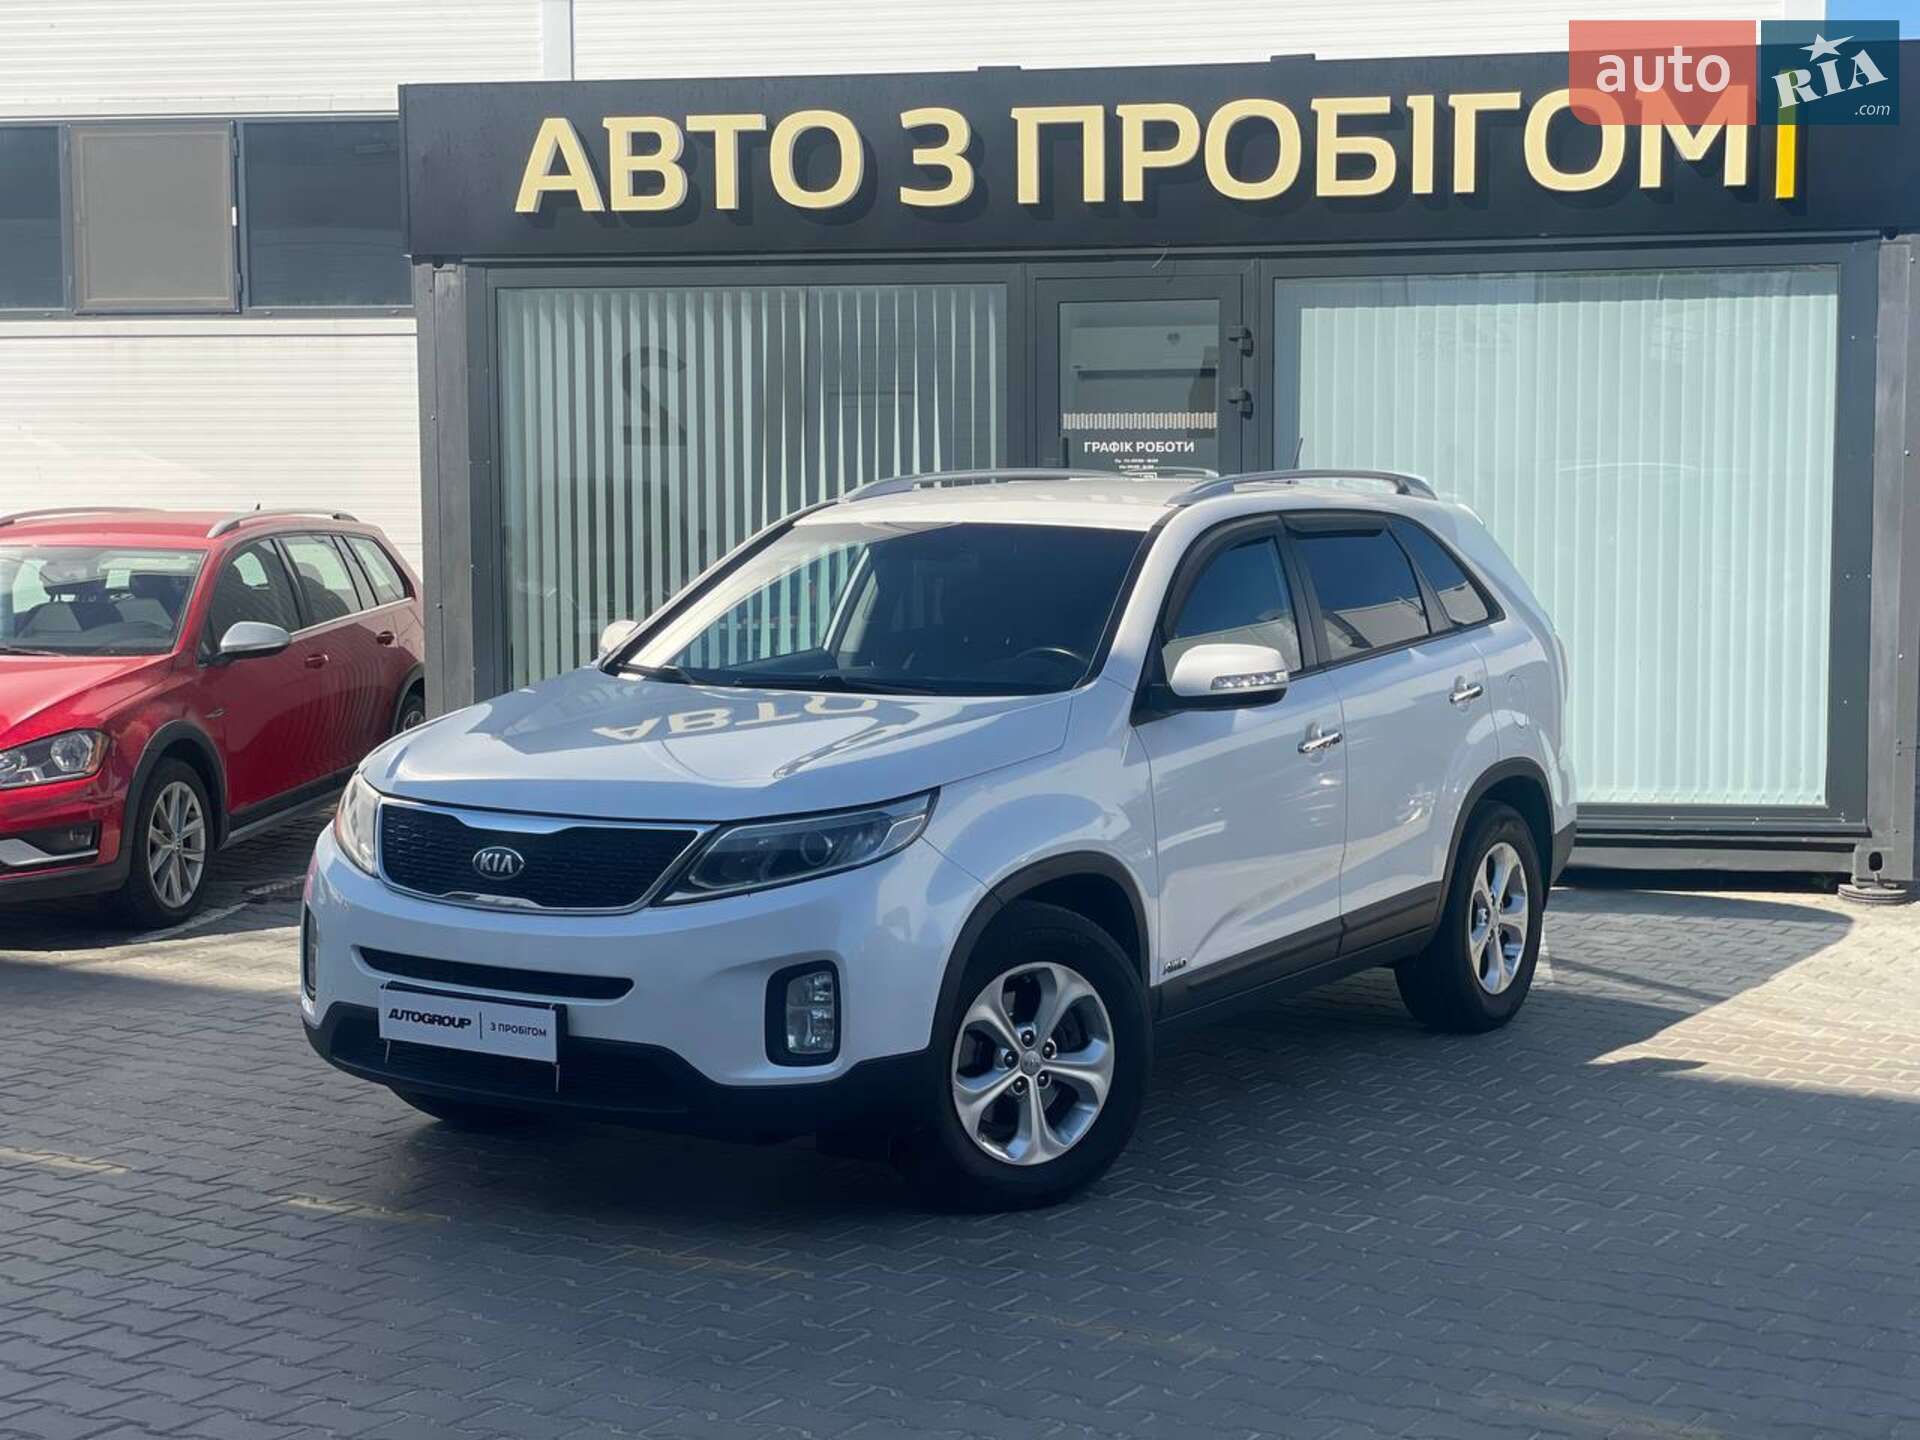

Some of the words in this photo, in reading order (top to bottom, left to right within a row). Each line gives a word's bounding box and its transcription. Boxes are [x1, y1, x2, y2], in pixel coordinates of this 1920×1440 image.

[514, 109, 864, 213] АВТО
[899, 107, 975, 207] З
[1011, 85, 1750, 205] ПРОБІГОМ
[1083, 441, 1133, 453] ГРАФІК
[1136, 441, 1195, 453] РОБОТИ
[479, 852, 513, 874] KIA
[388, 1008, 472, 1029] AUTOGROUP
[499, 1023, 547, 1037] ПРОБІГОМ
